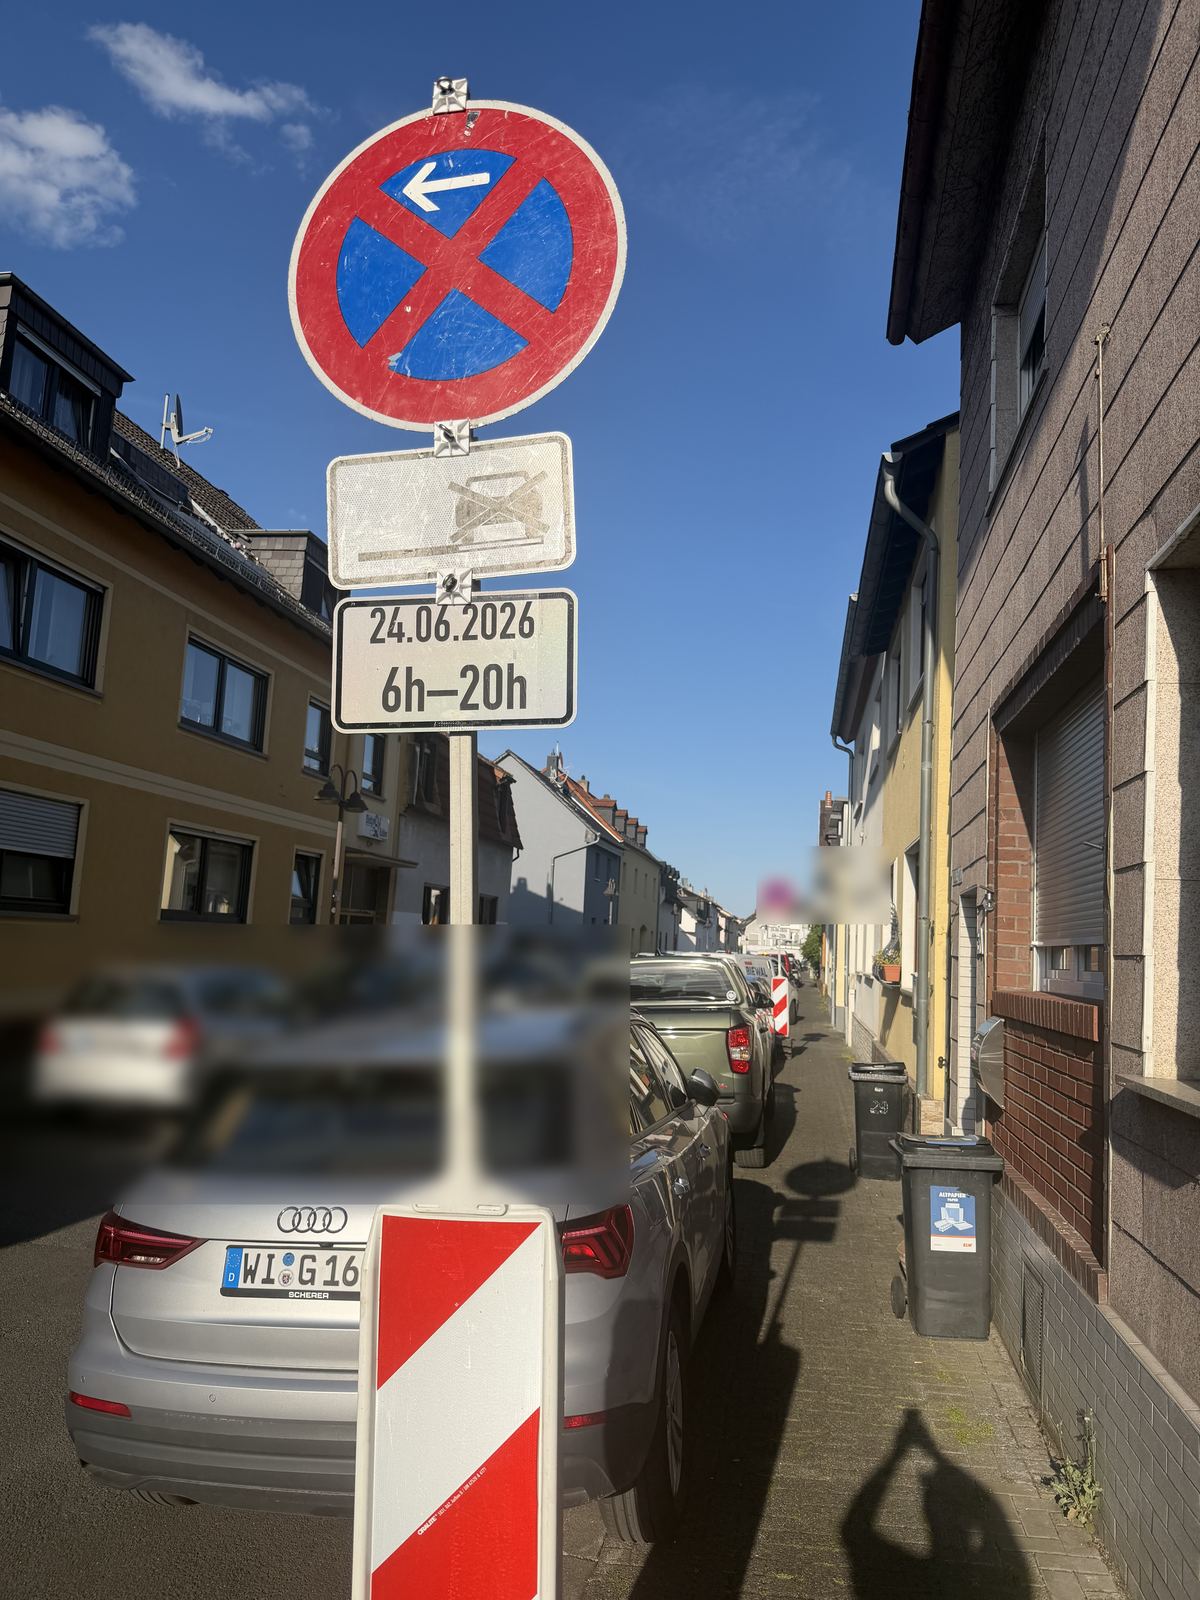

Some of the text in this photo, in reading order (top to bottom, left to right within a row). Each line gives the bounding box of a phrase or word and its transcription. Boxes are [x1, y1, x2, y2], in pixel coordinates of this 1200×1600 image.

[369, 602, 535, 644] 24.06.2026
[938, 1191, 967, 1199] ALTPAPIER
[243, 1252, 276, 1285] WI
[298, 1254, 317, 1286] G
[228, 1273, 235, 1282] D
[288, 1291, 329, 1300] SCHERER
